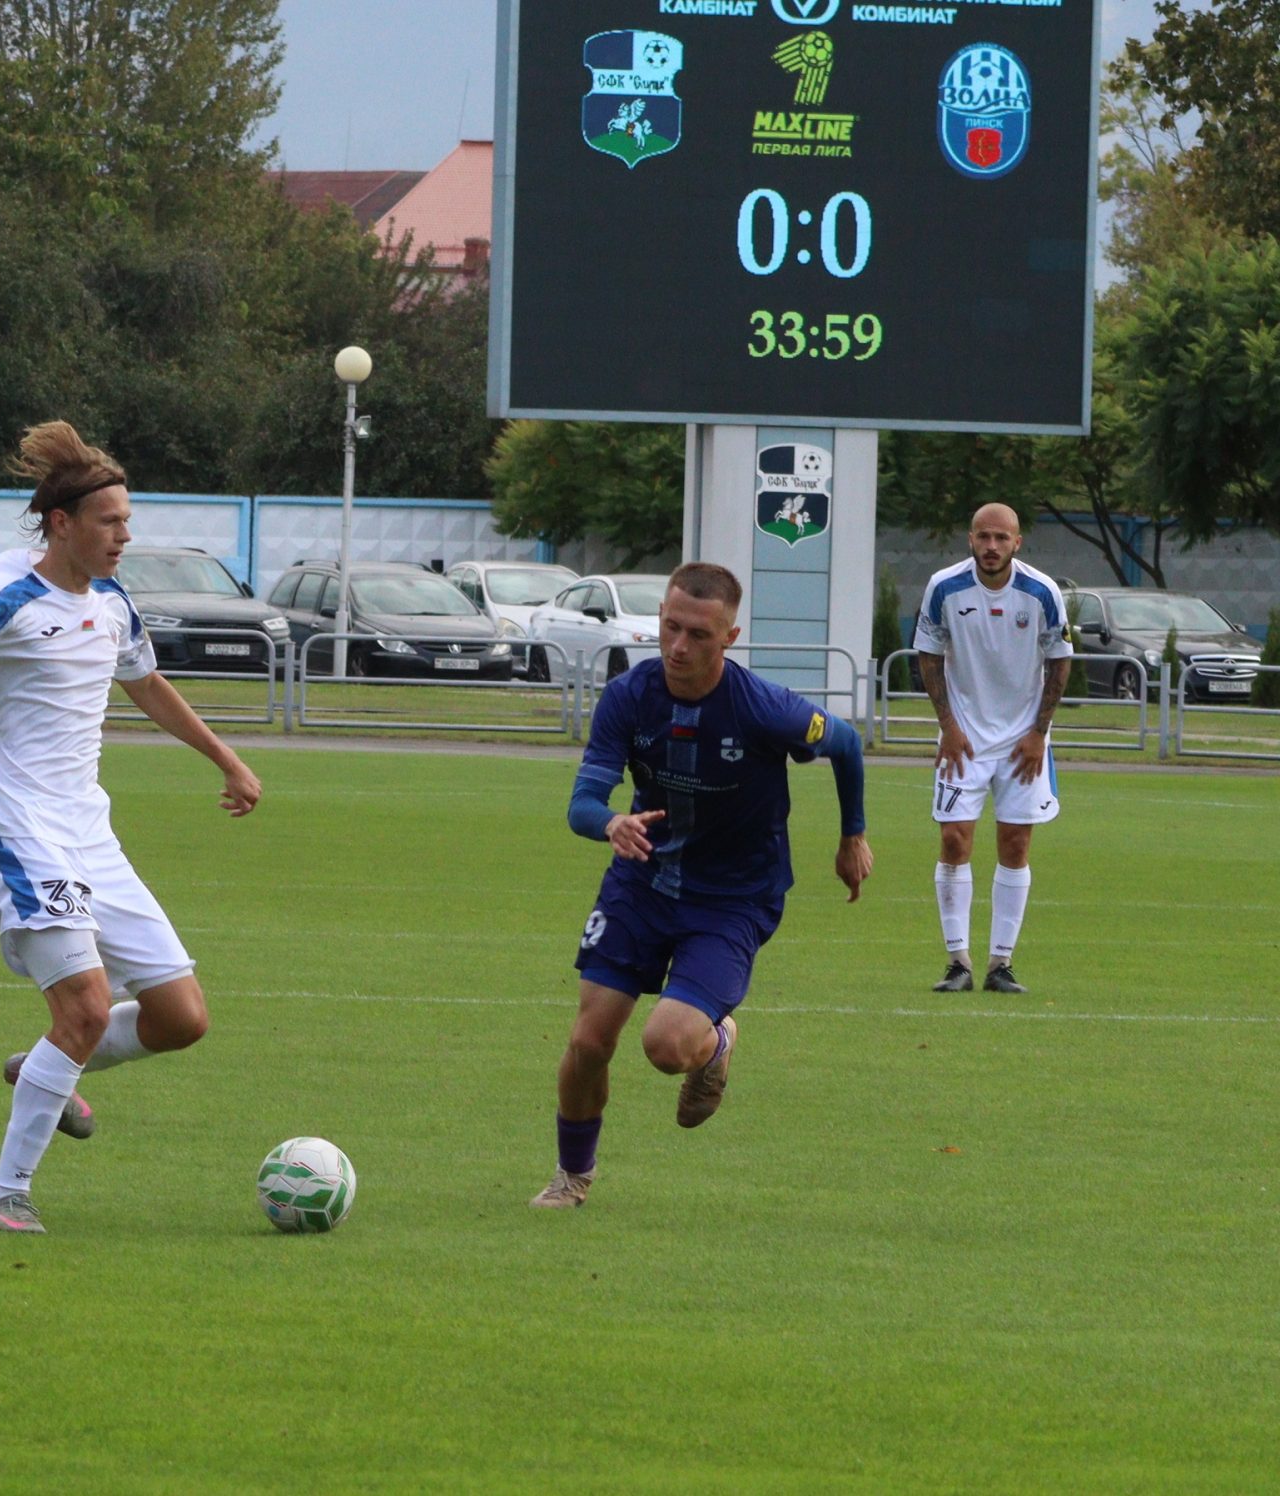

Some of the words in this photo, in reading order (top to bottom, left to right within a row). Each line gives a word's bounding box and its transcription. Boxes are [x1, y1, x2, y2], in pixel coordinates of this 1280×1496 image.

[659, 0, 757, 16] КАМБІНАТ
[852, 5, 957, 24] КОМБИНАТ
[753, 111, 854, 140] MAXLINE
[965, 118, 1003, 128] ПИНСК
[752, 143, 811, 155] ПЕРВАЯ
[813, 145, 852, 157] ЛИГА
[737, 188, 872, 279] 0:0
[748, 310, 882, 360] 33:59
[936, 781, 963, 813] 17
[581, 910, 607, 949] 9
